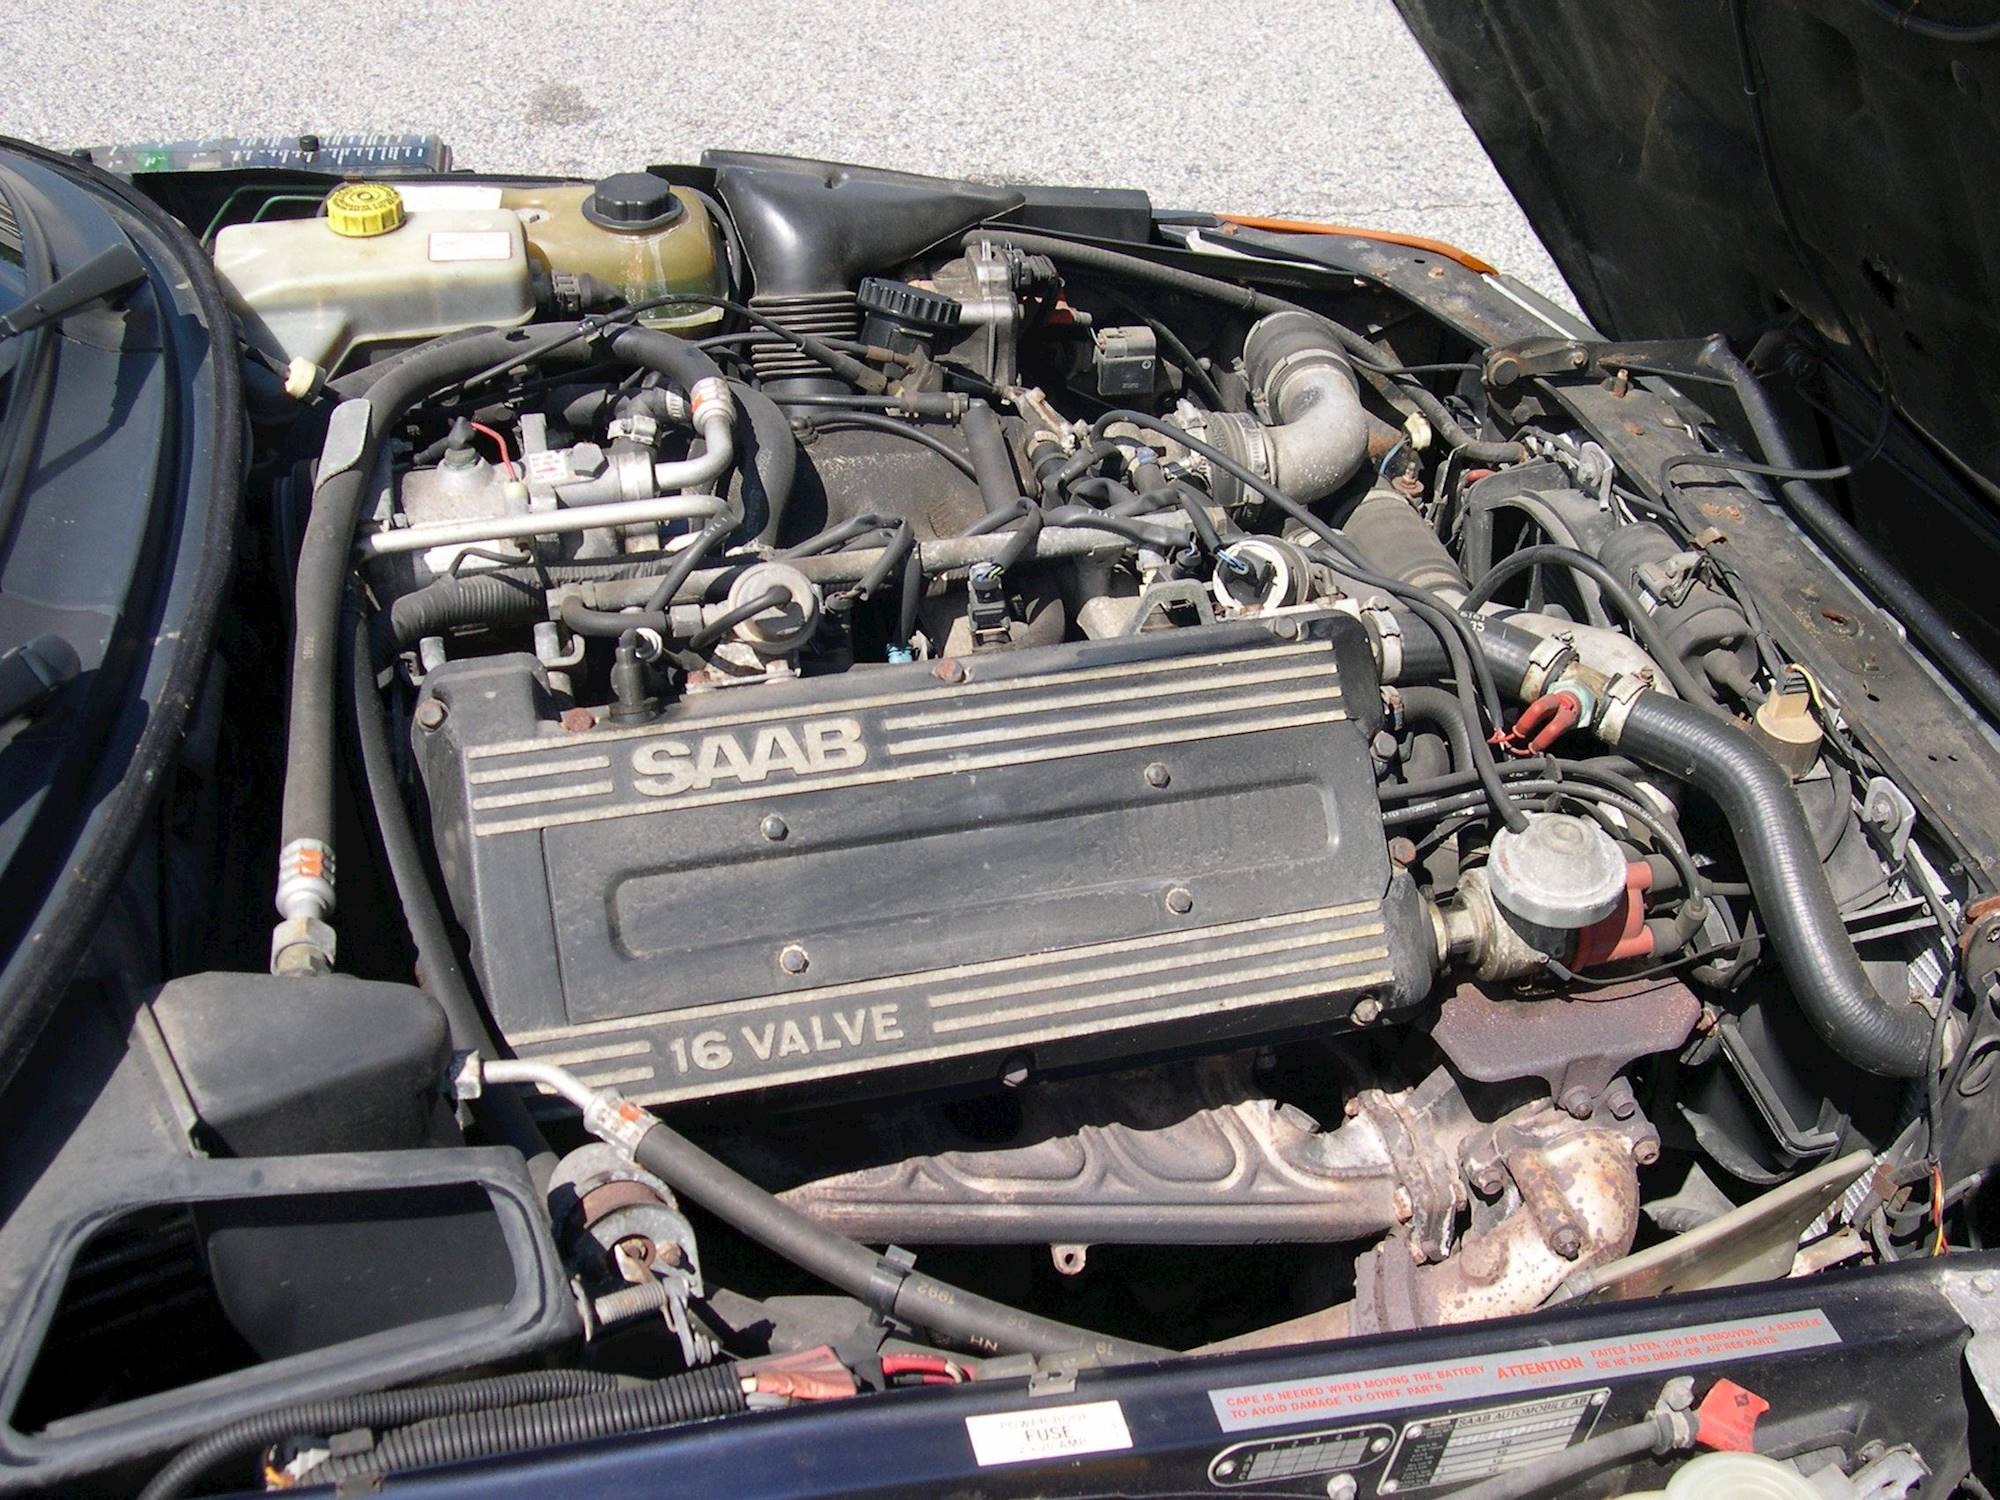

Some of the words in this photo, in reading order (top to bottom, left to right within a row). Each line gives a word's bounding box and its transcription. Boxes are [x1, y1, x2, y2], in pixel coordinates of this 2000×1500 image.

[703, 522, 722, 537] CYL
[631, 717, 869, 798] SAAB
[670, 1030, 735, 1076] 16
[741, 1002, 905, 1064] VALVE
[916, 1280, 955, 1305] 1992
[1496, 1356, 1584, 1380] ATTENTION
[1263, 1394, 1275, 1403] IS
[1277, 1387, 1324, 1400] NEEDED
[1327, 1381, 1361, 1394] WHEN
[1364, 1374, 1409, 1389] MOVING
[1413, 1371, 1433, 1383] THE
[1436, 1366, 1485, 1380] BATTERY
[1231, 1409, 1248, 1419] TO
[1251, 1404, 1288, 1417] AVOID
[1291, 1397, 1342, 1411] DAMAGE
[1347, 1394, 1363, 1403] TO
[1458, 1412, 1491, 1427] SAAB
[1493, 1399, 1569, 1421] AUTOMOBILE
[1570, 1396, 1589, 1408] AB
[1024, 1425, 1074, 1442] FUSE
